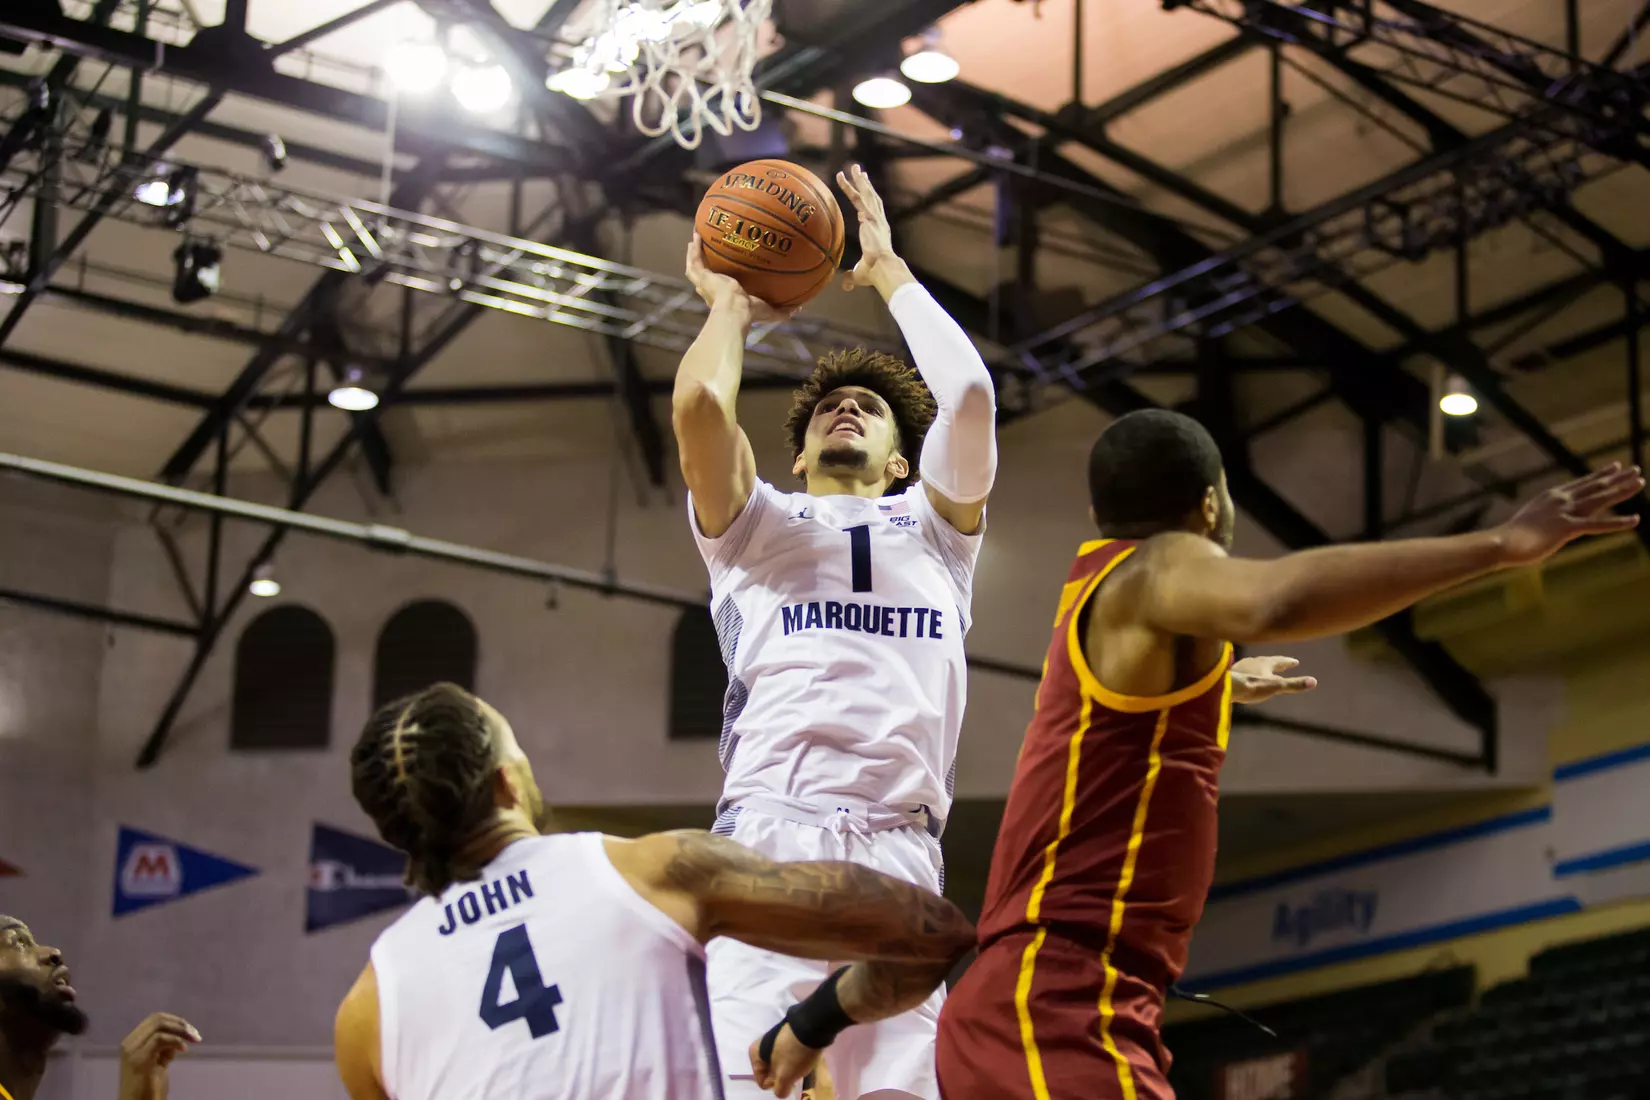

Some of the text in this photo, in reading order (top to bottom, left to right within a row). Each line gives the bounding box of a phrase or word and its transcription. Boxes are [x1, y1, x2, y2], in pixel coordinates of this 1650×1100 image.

[720, 173, 816, 223] SPALDING
[708, 206, 793, 253] TF-1000
[842, 524, 873, 593] 1
[781, 601, 943, 640] MARQUETTE
[438, 869, 534, 936] JOHN
[479, 923, 564, 1040] 4
